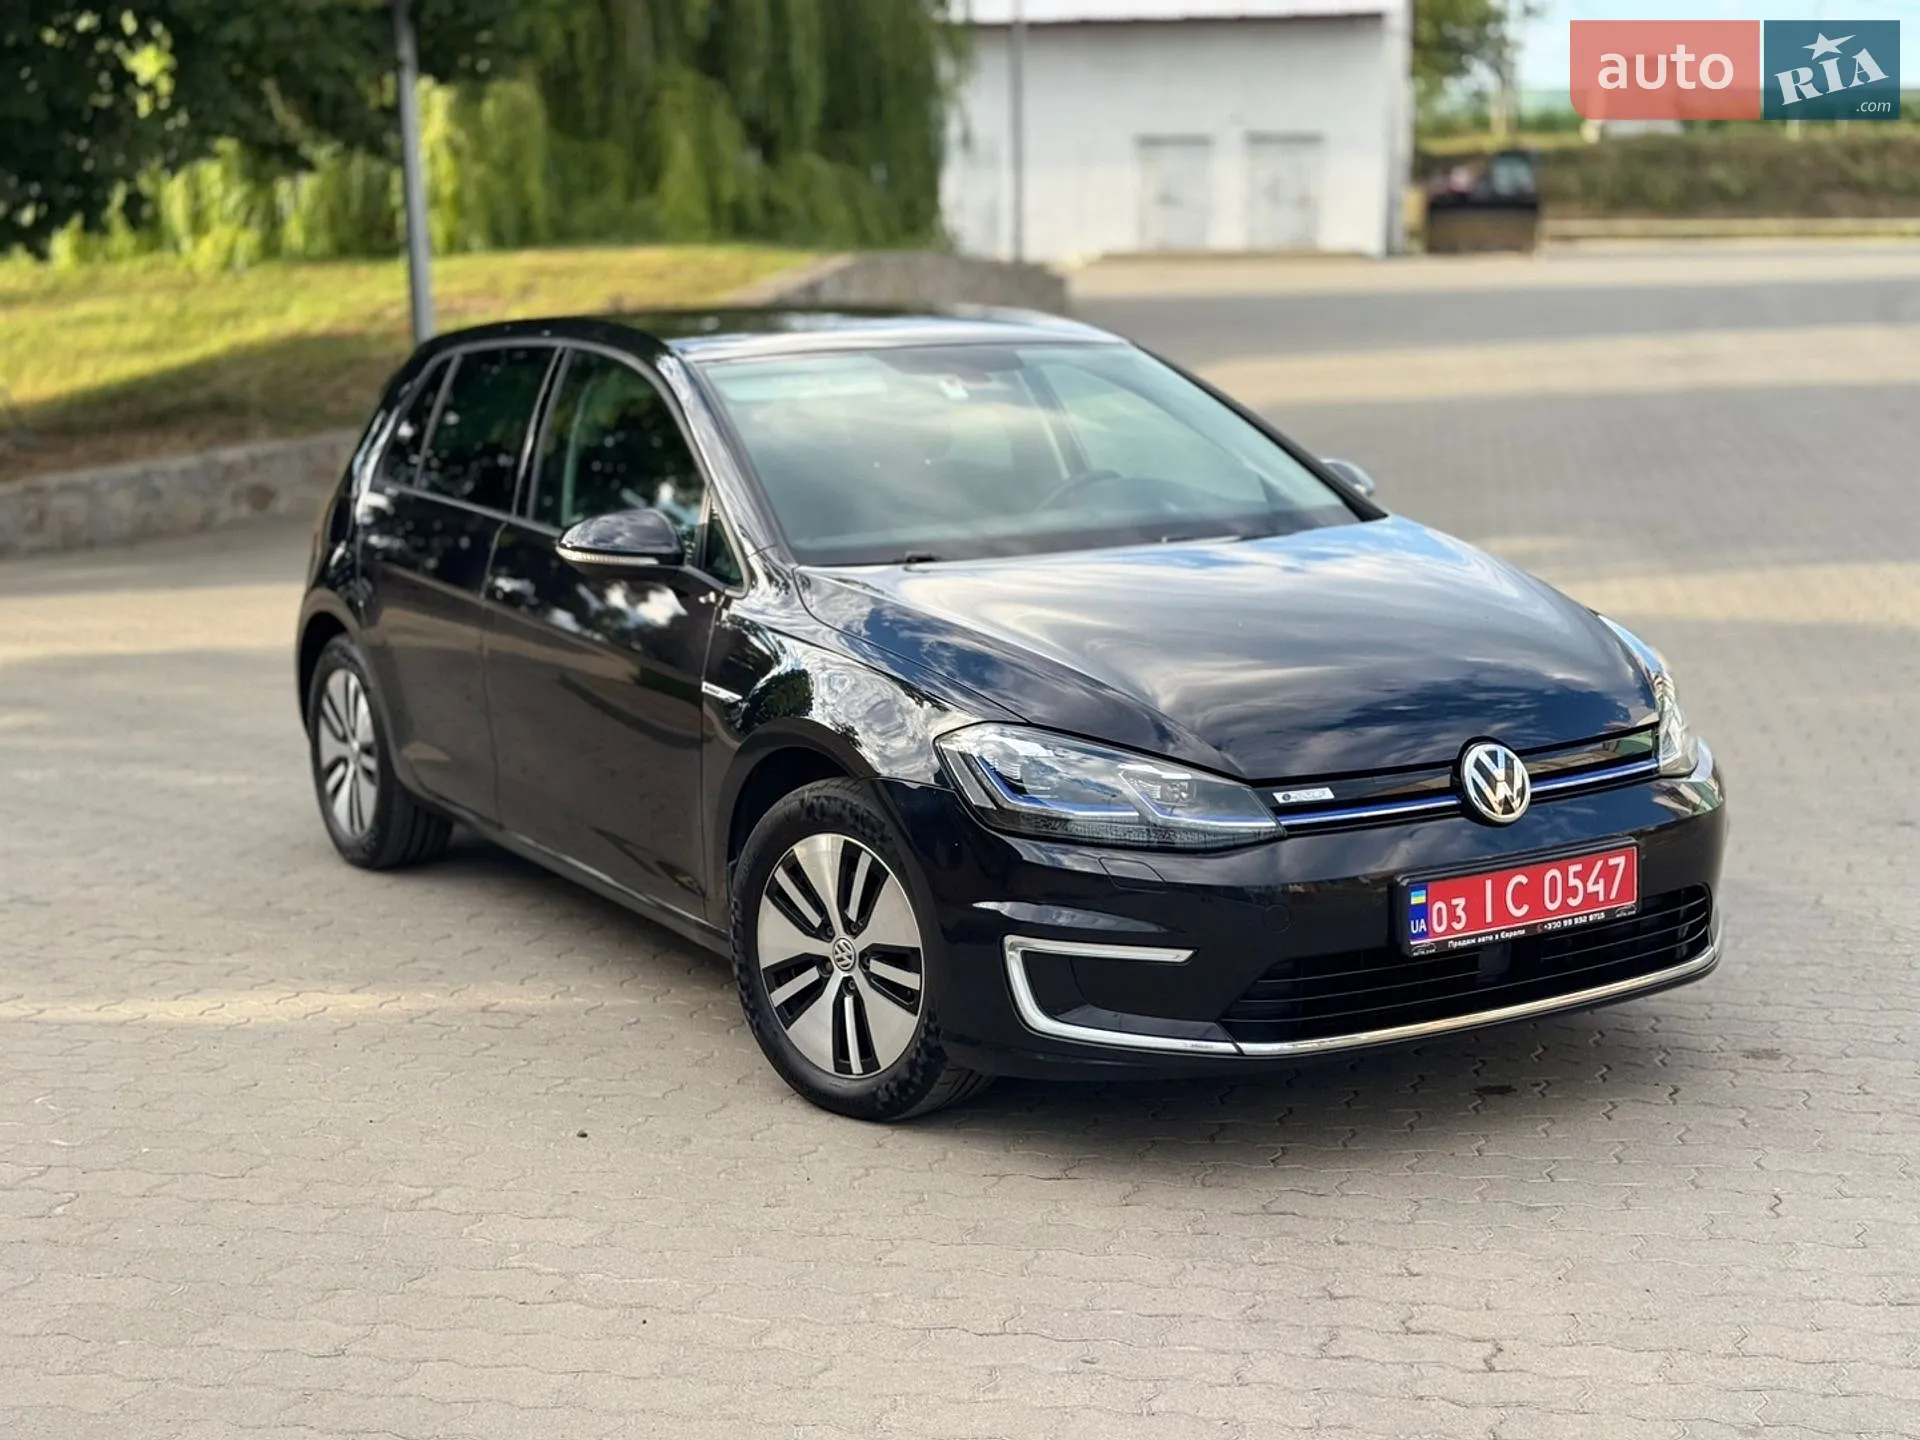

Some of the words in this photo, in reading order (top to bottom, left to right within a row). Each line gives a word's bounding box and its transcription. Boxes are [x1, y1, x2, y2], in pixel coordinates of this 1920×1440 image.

[1432, 897, 1467, 933] 03
[1544, 856, 1625, 911] 0547
[1411, 918, 1427, 934] UA
